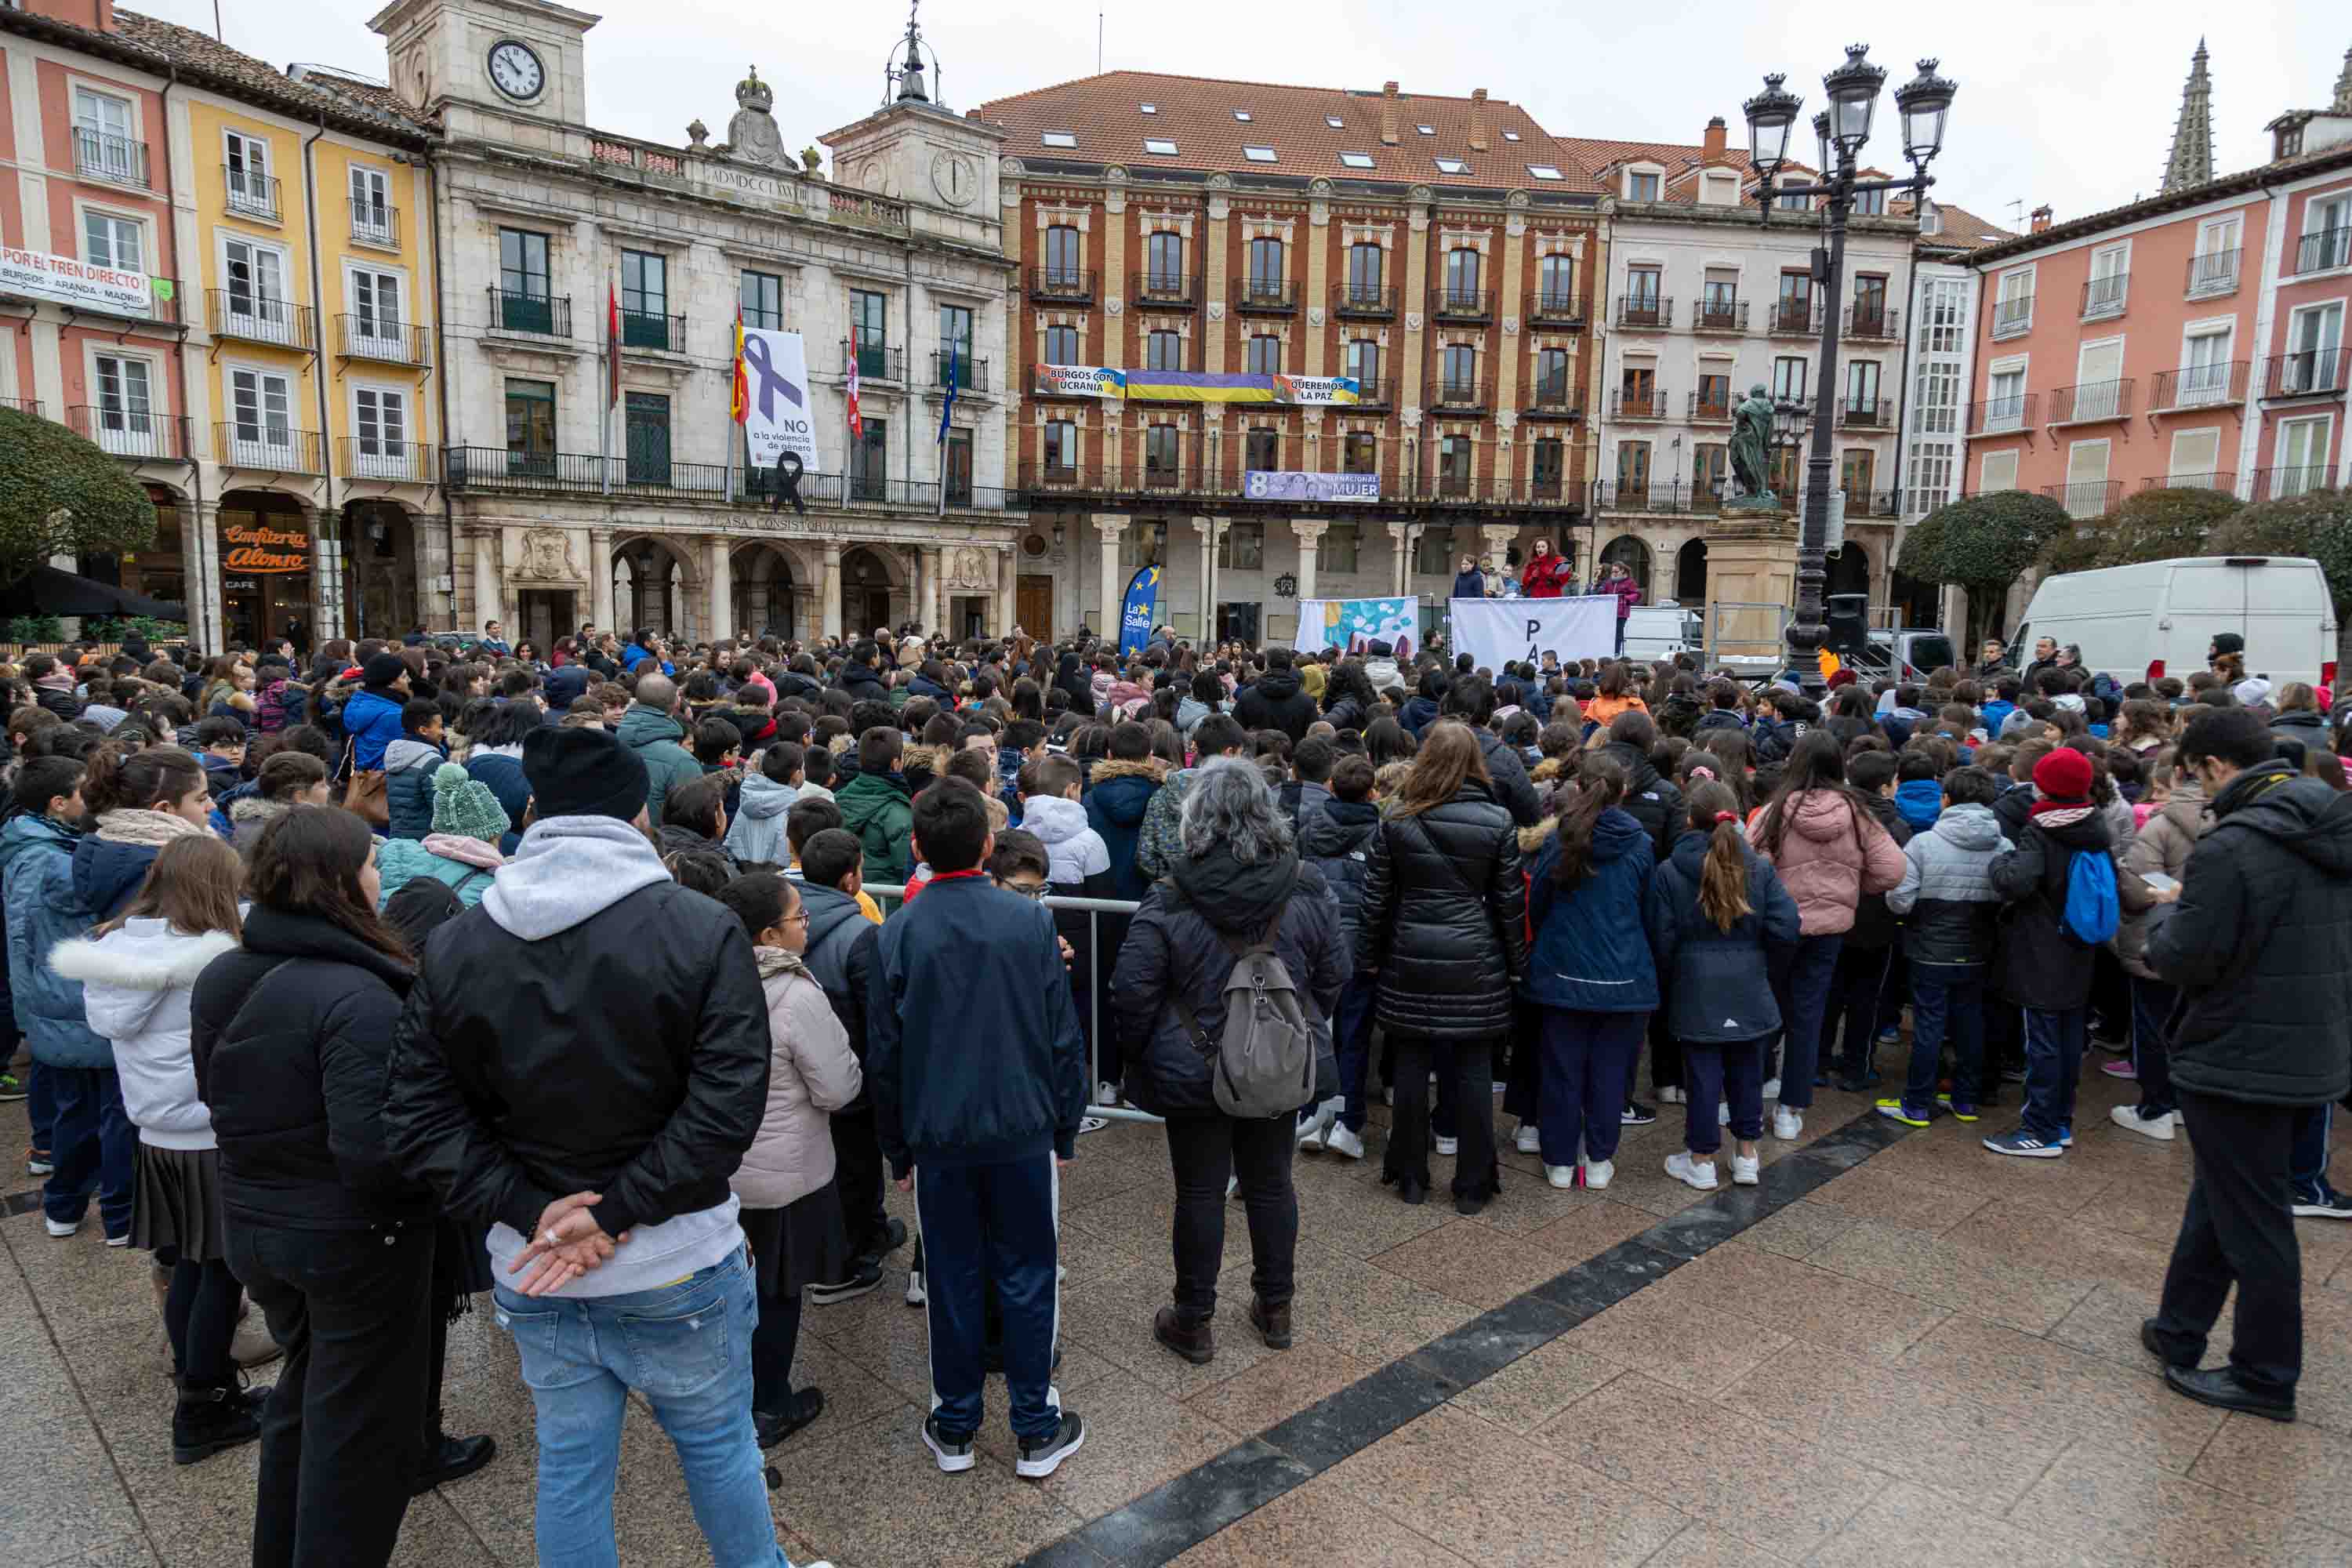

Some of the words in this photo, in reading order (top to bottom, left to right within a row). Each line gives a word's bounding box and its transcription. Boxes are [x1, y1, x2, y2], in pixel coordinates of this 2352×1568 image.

[34, 256, 48, 270] EL
[49, 260, 85, 277] TREN
[87, 267, 139, 289] DIRECTO
[2, 268, 45, 285] BURGOS
[54, 280, 97, 296] ARANDA
[104, 289, 144, 303] MADRID
[1051, 370, 1091, 380] BURGOS
[1094, 372, 1113, 382] CON
[1060, 381, 1104, 392] UCRANIA
[1291, 381, 1343, 390] QUEREMOS
[1315, 392, 1333, 401] PAZ
[785, 419, 808, 434] NO
[761, 431, 769, 440] la
[771, 433, 810, 443] violencia
[768, 441, 779, 450] de
[782, 442, 811, 452] género
[1250, 473, 1268, 497] 8
[1333, 483, 1378, 495] MUJER
[226, 547, 304, 570] Alonso
[1127, 602, 1138, 615] La
[1125, 615, 1150, 628] Salle
